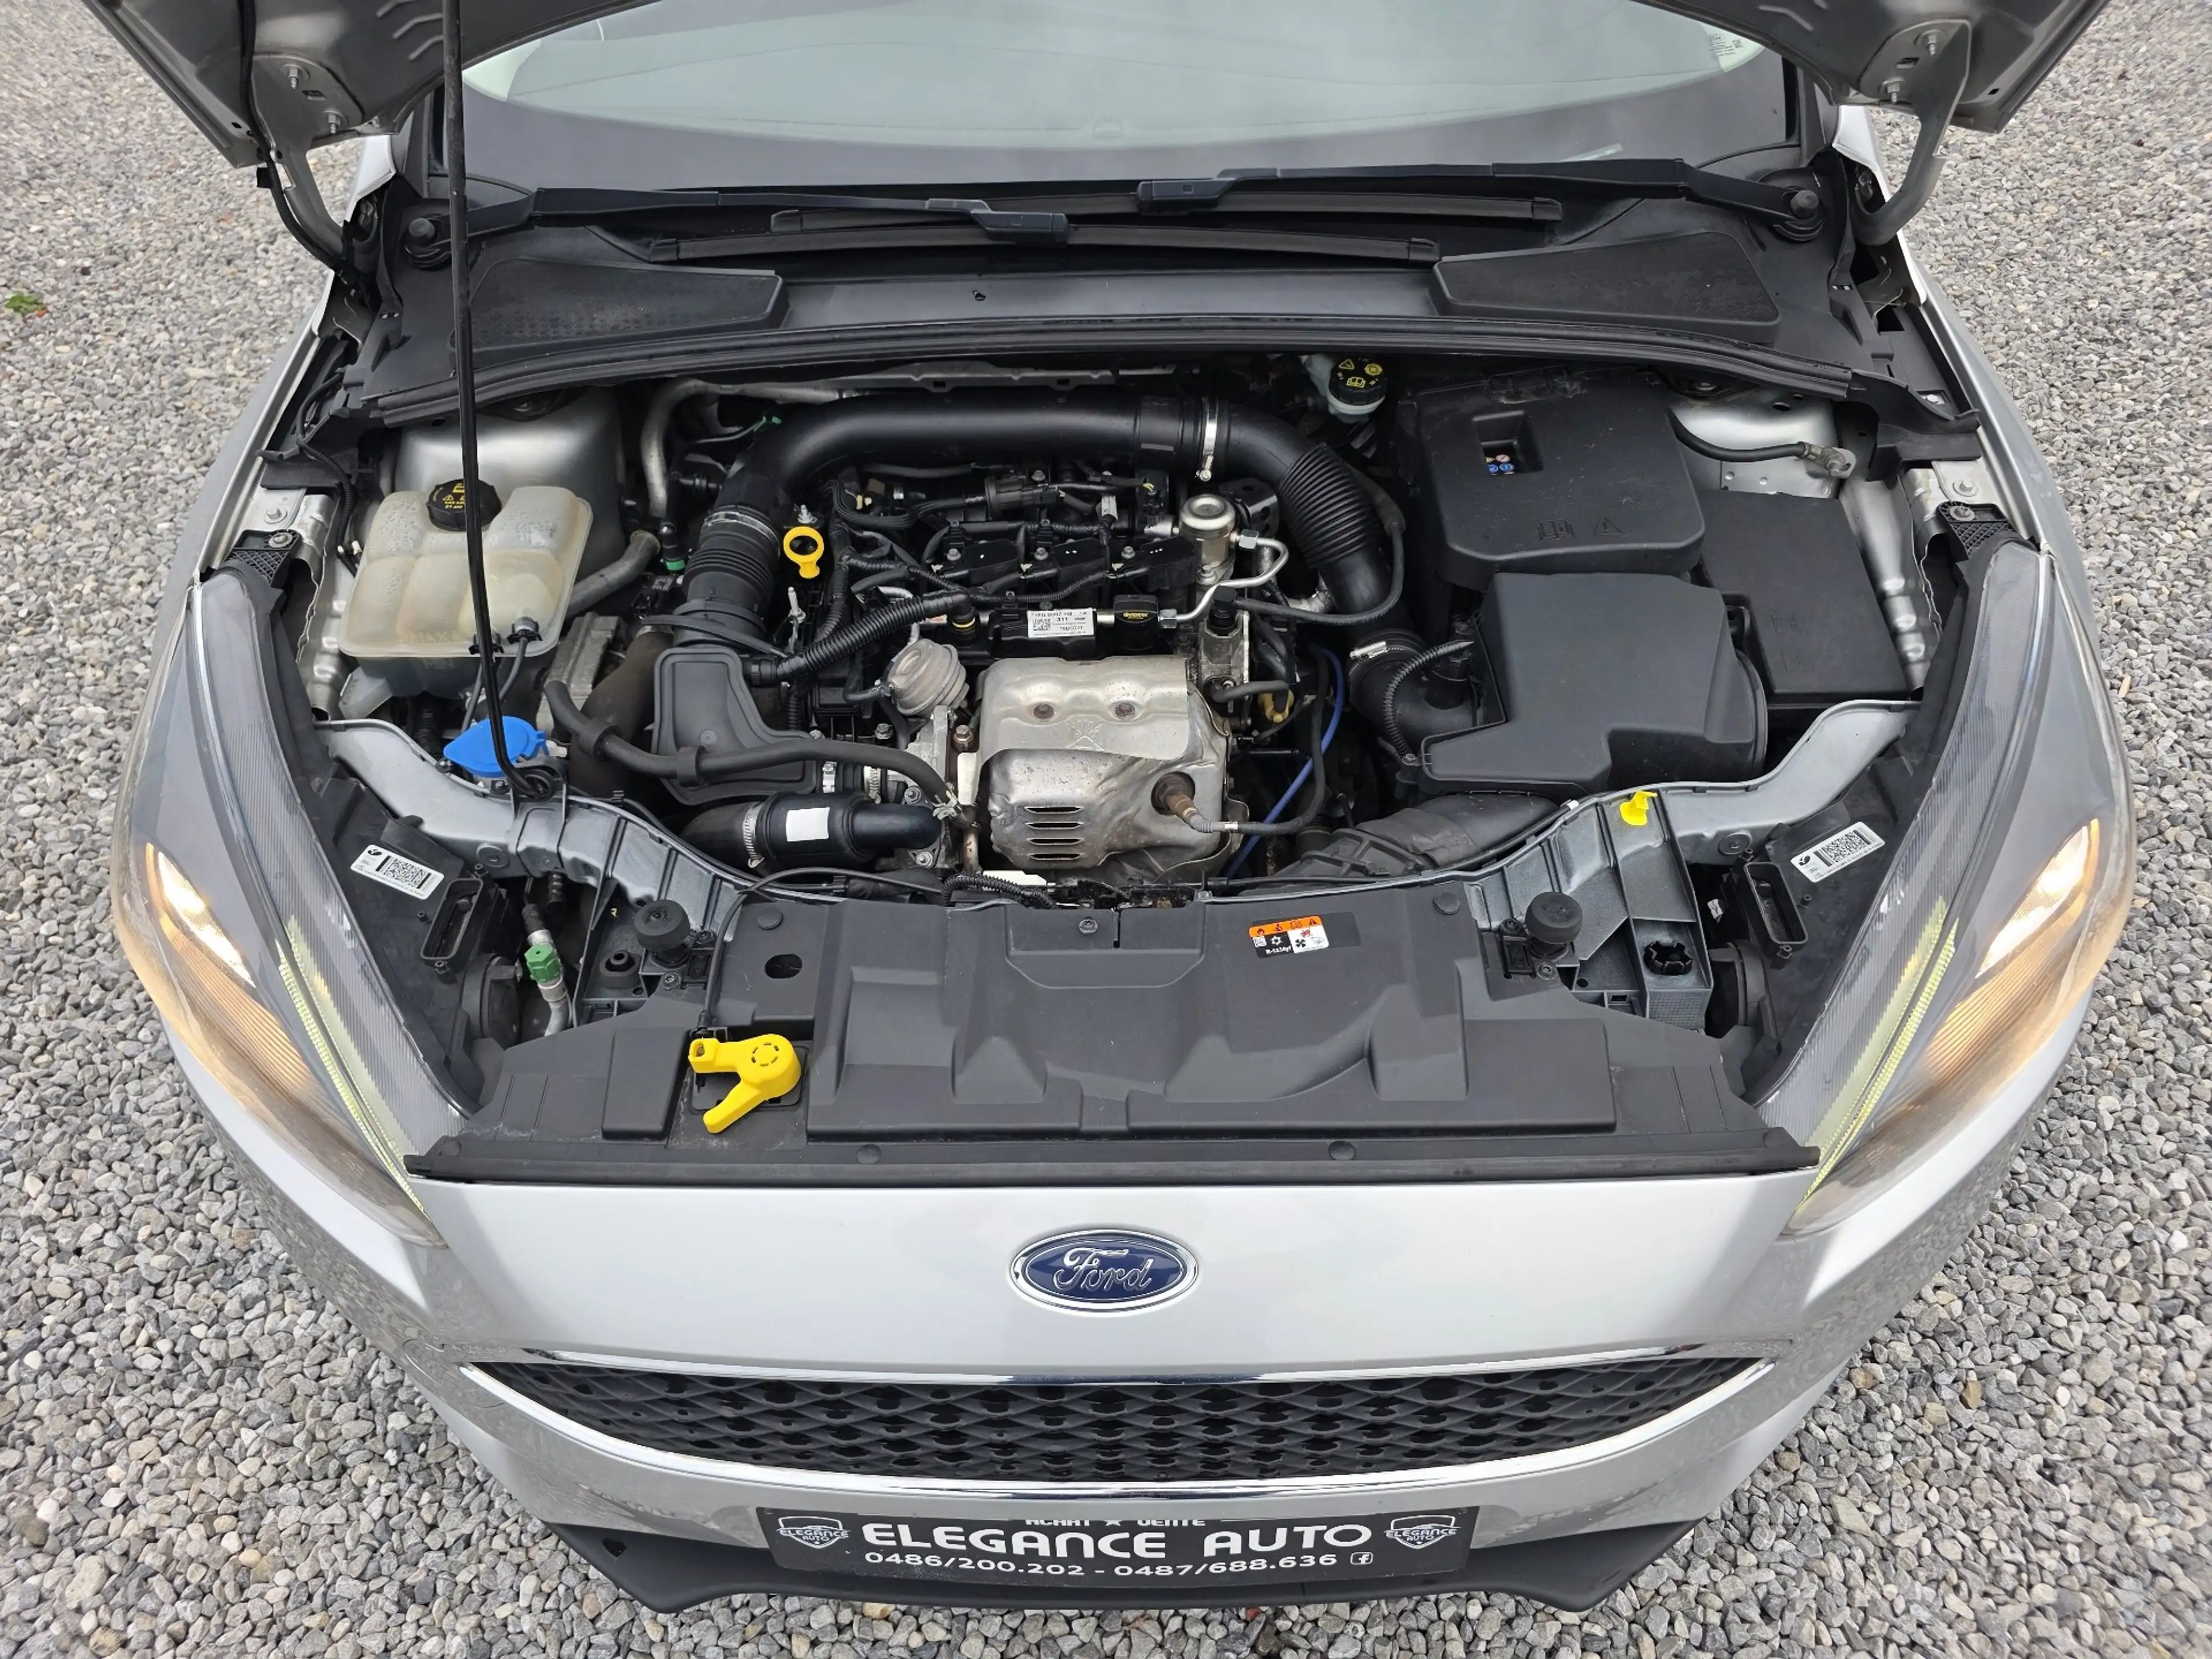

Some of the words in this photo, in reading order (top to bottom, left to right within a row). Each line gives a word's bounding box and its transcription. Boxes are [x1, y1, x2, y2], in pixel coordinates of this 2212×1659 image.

[1053, 1247, 1155, 1291] Ford
[779, 1529, 849, 1539] ELEGANCE
[862, 1522, 1166, 1559] ELEGANCE
[1203, 1524, 1372, 1558] AUTO
[1385, 1528, 1457, 1539] ELEGANCE
[865, 1551, 1085, 1576] 0486/200.202
[1114, 1554, 1338, 1576] 0487/688.636
